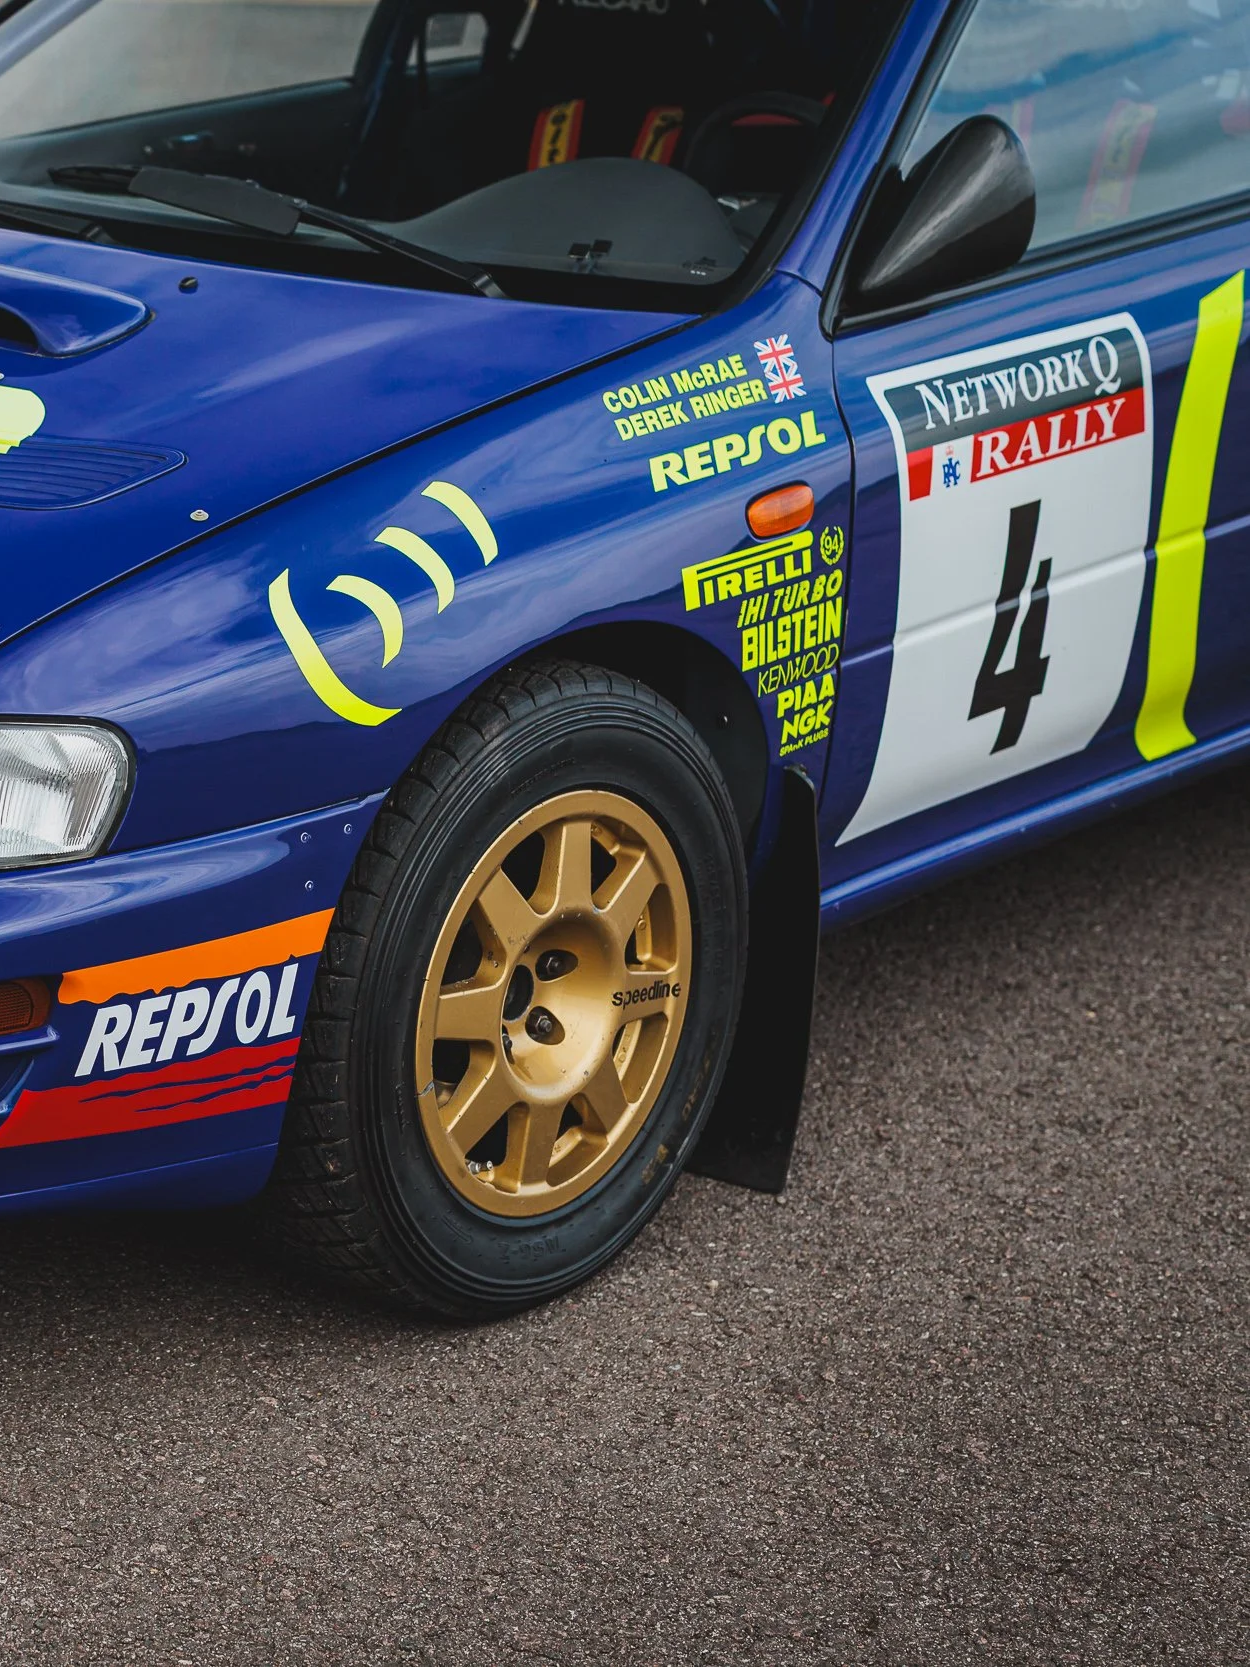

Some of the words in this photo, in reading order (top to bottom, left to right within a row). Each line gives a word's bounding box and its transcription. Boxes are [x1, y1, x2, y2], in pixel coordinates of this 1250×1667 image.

[602, 376, 671, 413] COLIN
[671, 354, 747, 394] McRAE
[614, 401, 690, 441] DEREK
[689, 379, 768, 419] RINGER
[915, 349, 1089, 430] NETWORK
[1088, 336, 1122, 396] Q
[649, 410, 826, 492] REPSOL
[976, 398, 1126, 478] RALLY
[681, 530, 815, 612] PIRELLI
[824, 534, 839, 556] 94
[737, 593, 770, 629] IHI
[771, 568, 843, 617] TURBO
[967, 499, 1052, 755] 4
[741, 597, 842, 672] BILSTEIN
[758, 643, 839, 698] KENWOOD
[777, 673, 835, 718] PIAA
[781, 699, 833, 744] NGK
[805, 728, 829, 746] PLUGS
[74, 962, 301, 1077] REPSOL
[612, 980, 681, 1010] speedline
